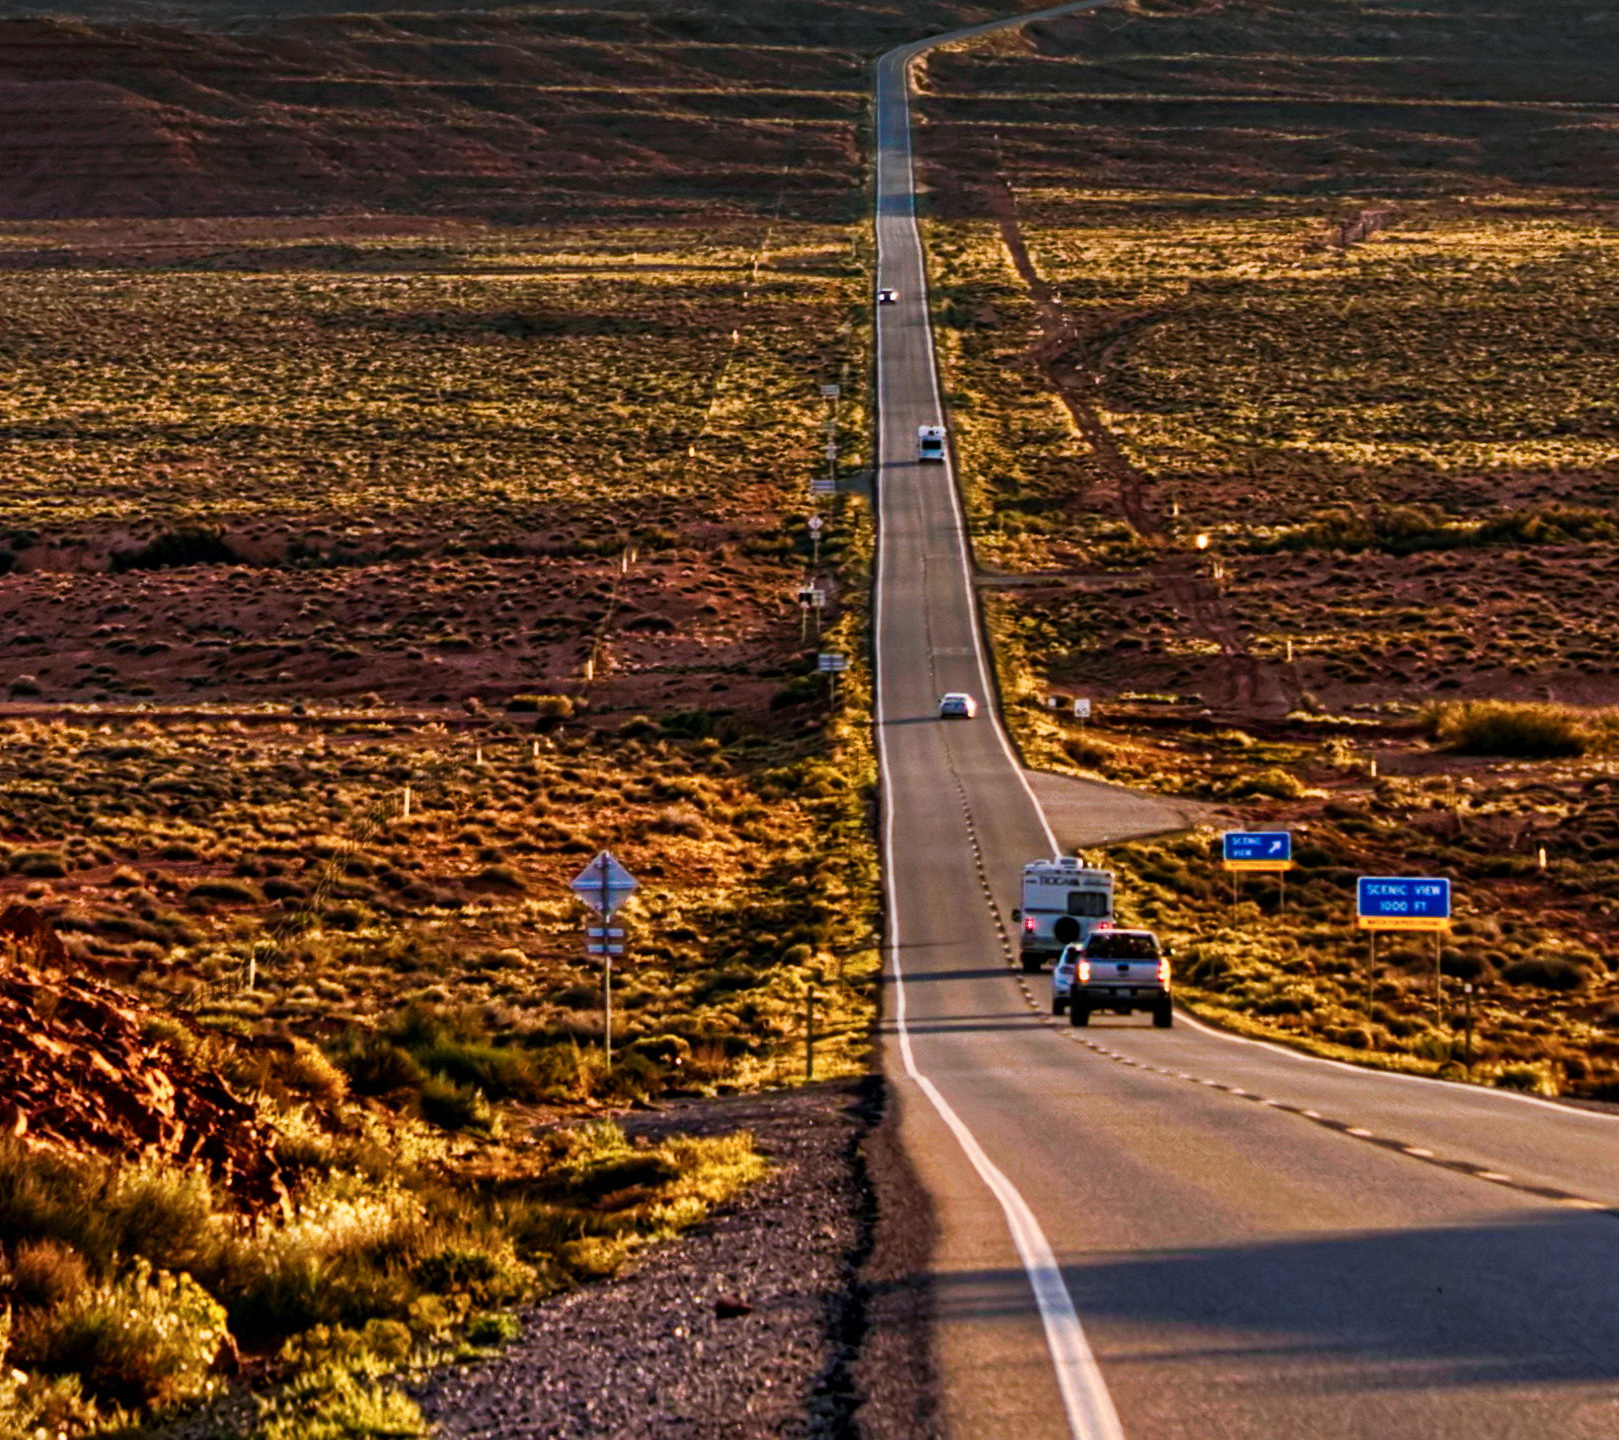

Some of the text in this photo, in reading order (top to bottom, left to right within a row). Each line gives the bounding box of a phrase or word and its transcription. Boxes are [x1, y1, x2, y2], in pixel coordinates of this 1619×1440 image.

[1367, 884, 1441, 895] SCENIC VIEW
[1380, 901, 1427, 912] 1000 FT
